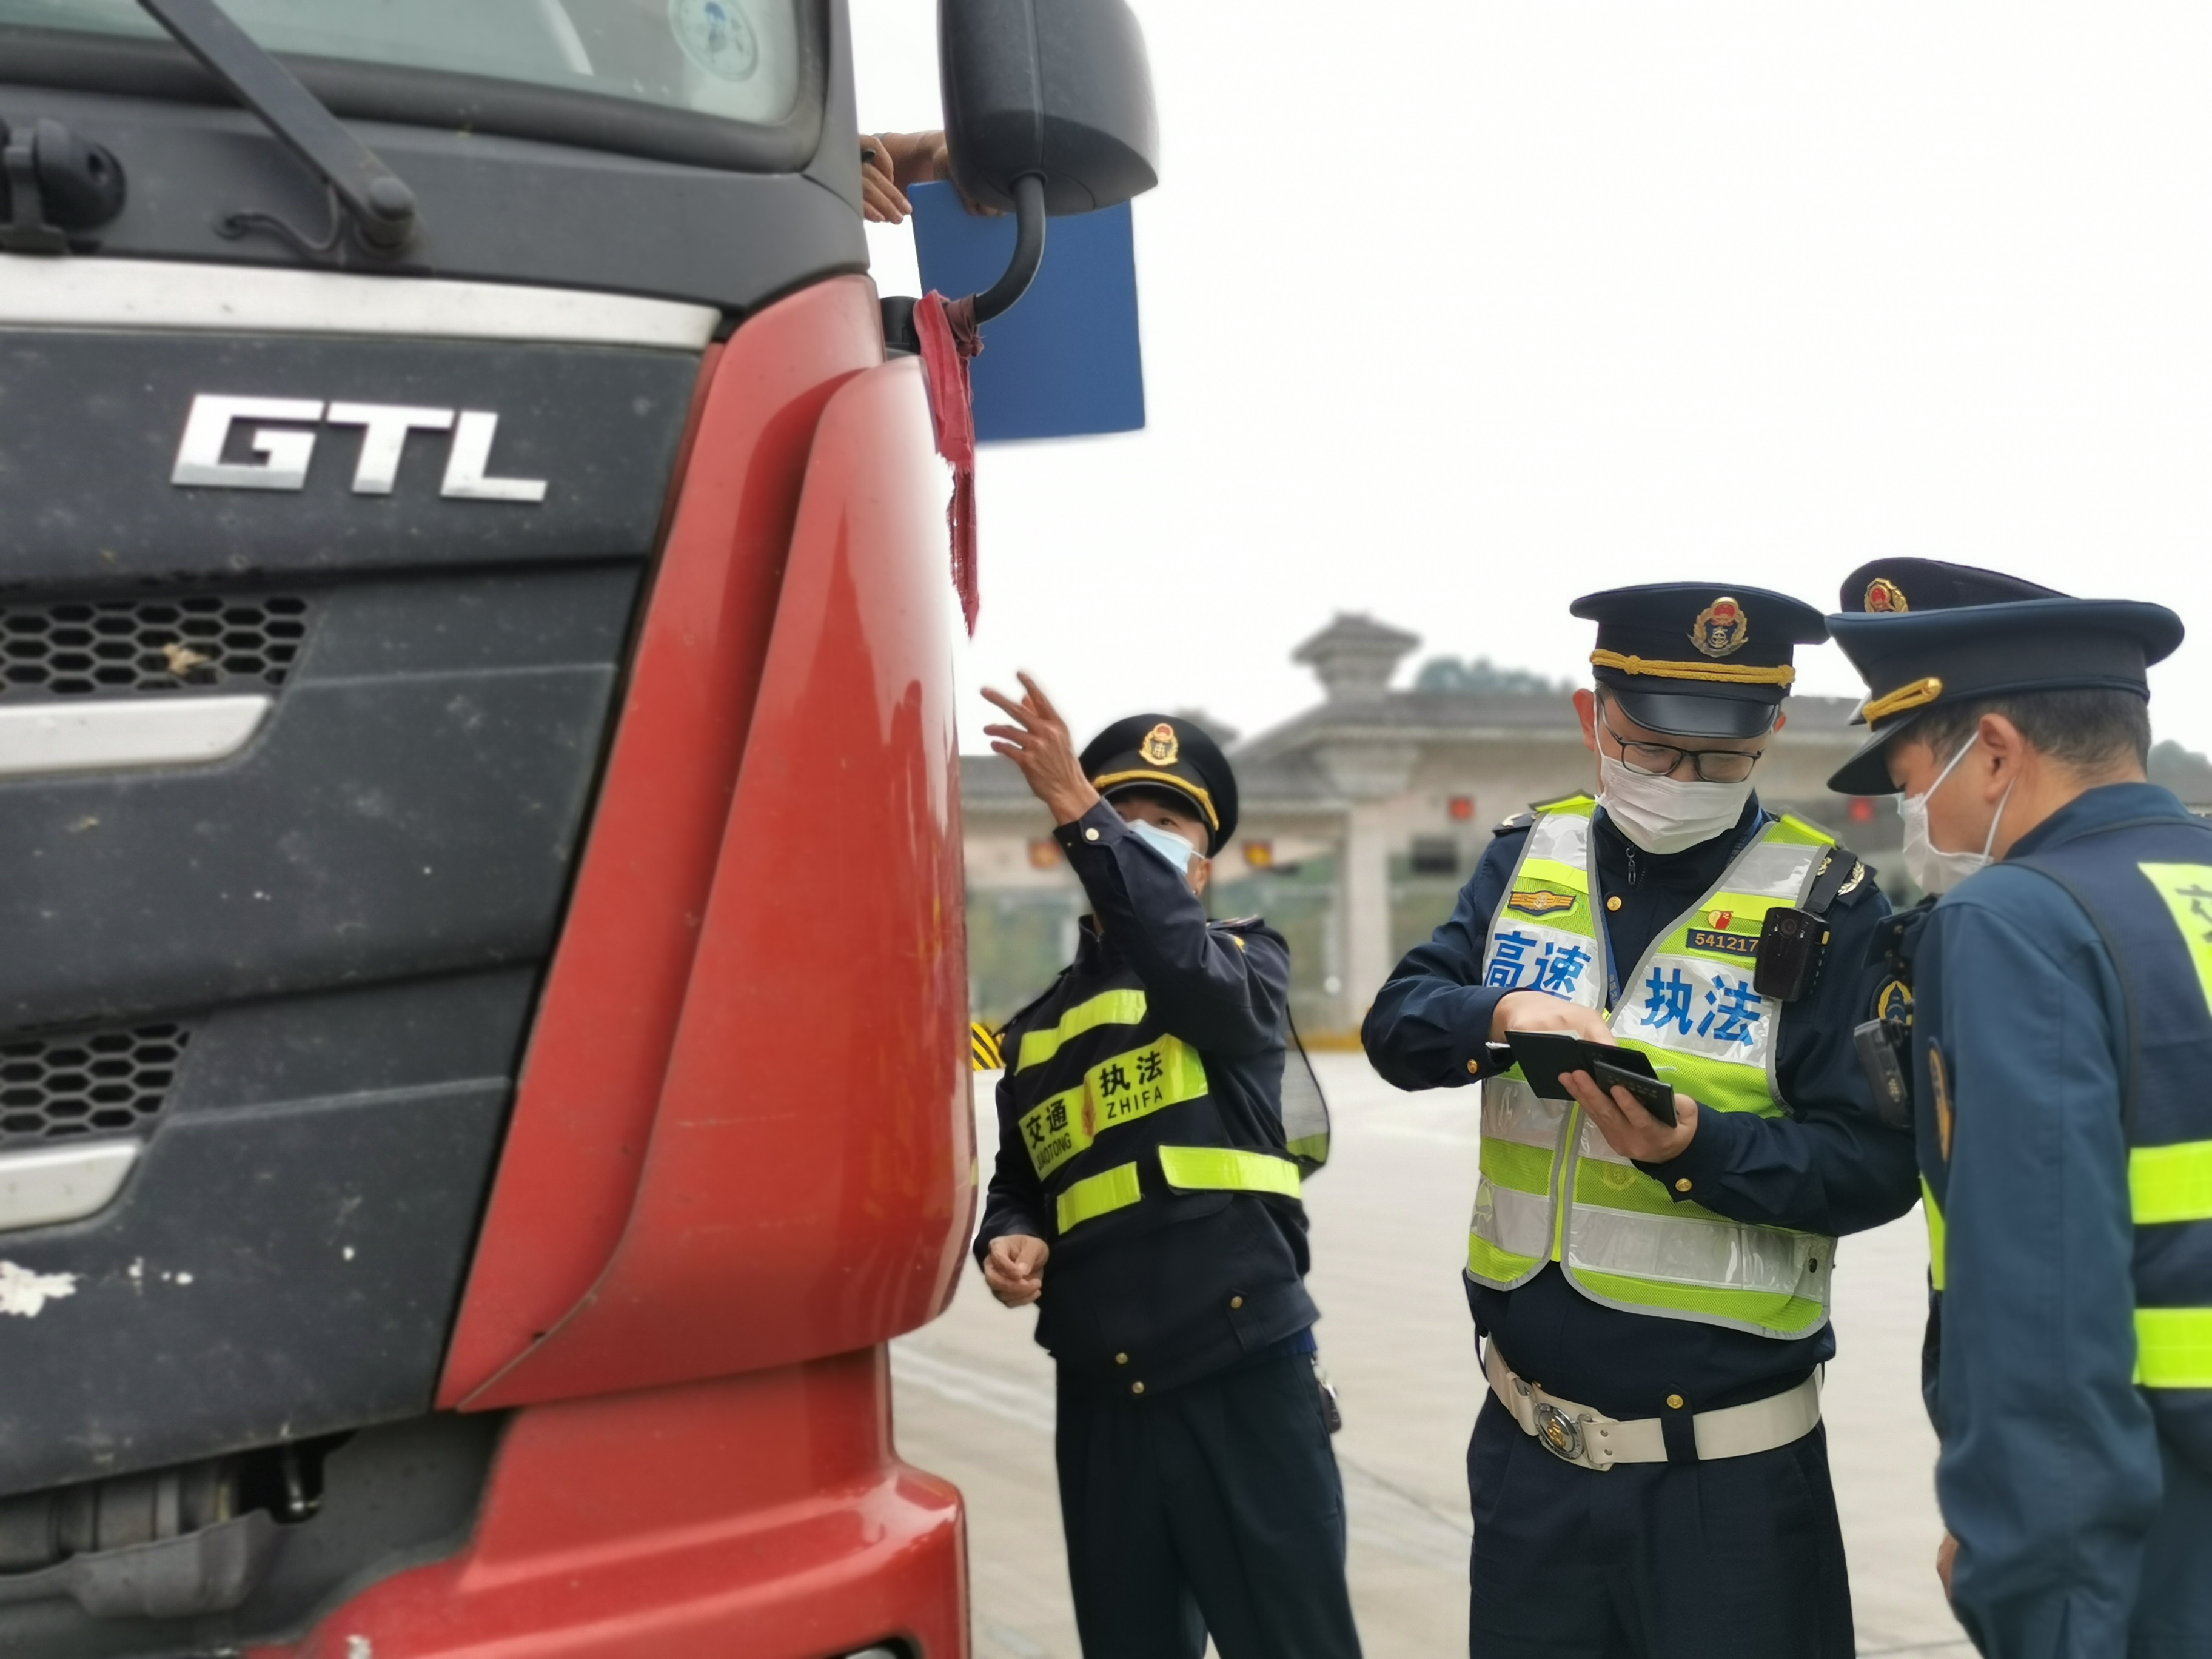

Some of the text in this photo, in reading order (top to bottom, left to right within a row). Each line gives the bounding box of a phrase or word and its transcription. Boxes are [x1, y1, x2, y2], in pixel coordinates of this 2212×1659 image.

[171, 394, 547, 502] GTL
[1485, 930, 1761, 1047] 高速 执法
[1695, 933, 1759, 953] 541217
[1026, 1050, 1164, 1150] 交通 执法
[1036, 1085, 1163, 1171] JIAOTONG ZHIFA
